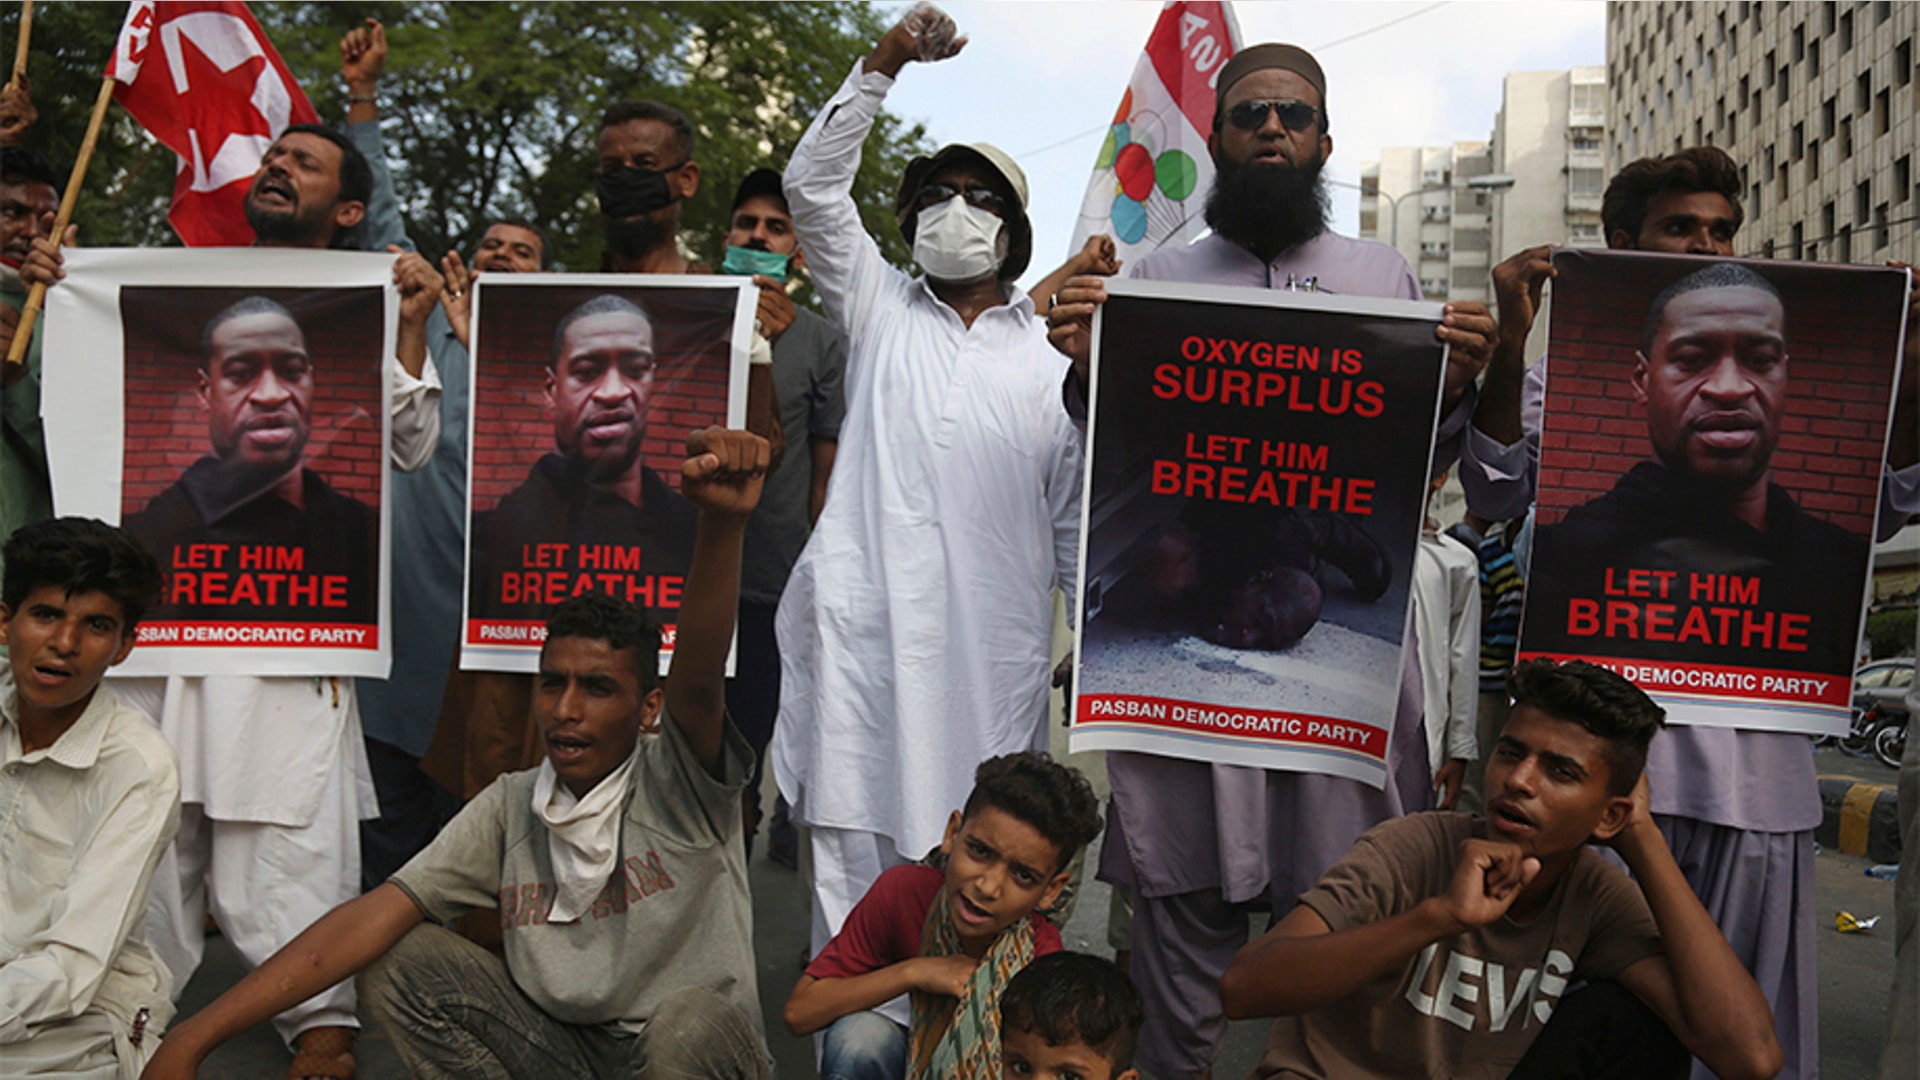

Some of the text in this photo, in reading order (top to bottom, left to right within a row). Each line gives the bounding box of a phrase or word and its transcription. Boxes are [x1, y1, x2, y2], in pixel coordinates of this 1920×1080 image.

[1181, 336, 1363, 375] OXYGEN IS
[1151, 363, 1386, 418] SURPLUS
[1185, 432, 1329, 471] LET HIM
[1151, 459, 1376, 515] BREATHE
[172, 543, 304, 570] LET HIM
[522, 543, 641, 571] LET HIM
[501, 571, 684, 608] BREATHE
[1604, 567, 1761, 605] LET HIM
[135, 626, 366, 643] SBAN DEMOCRATIC PARTY
[480, 625, 527, 639] PASBAN
[1567, 597, 1811, 652] BREATHE
[1622, 665, 1756, 692] DEMOCRATIC
[1762, 676, 1829, 696] PARTY
[1090, 700, 1371, 745] PASBAN DEMOCRATIC PARTY
